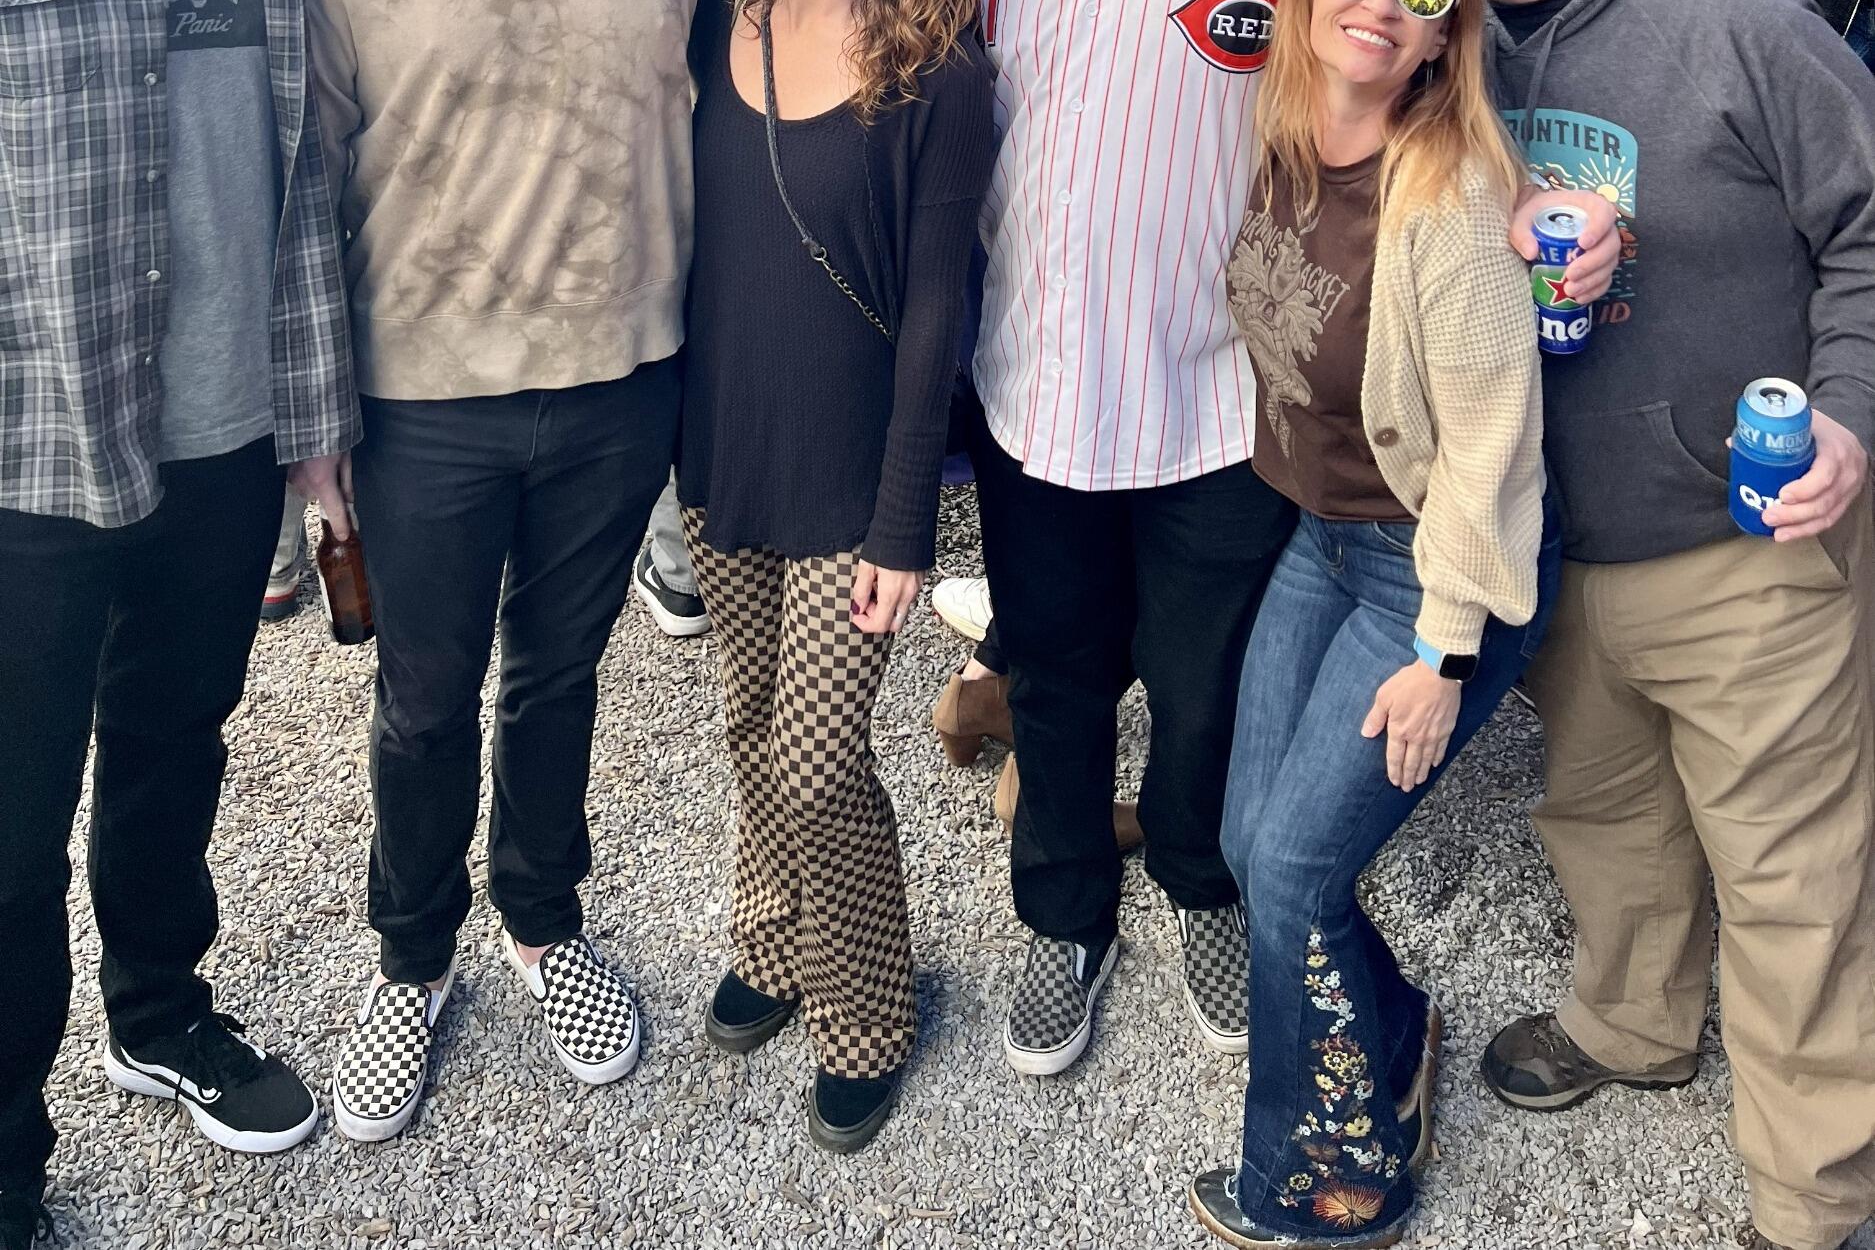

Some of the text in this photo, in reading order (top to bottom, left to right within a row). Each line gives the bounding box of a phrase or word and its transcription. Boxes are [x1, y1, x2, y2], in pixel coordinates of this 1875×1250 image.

[169, 12, 233, 38] Panic
[1212, 13, 1275, 40] RED
[1504, 117, 1622, 160] ONTIER
[1300, 257, 1351, 324] ACKET
